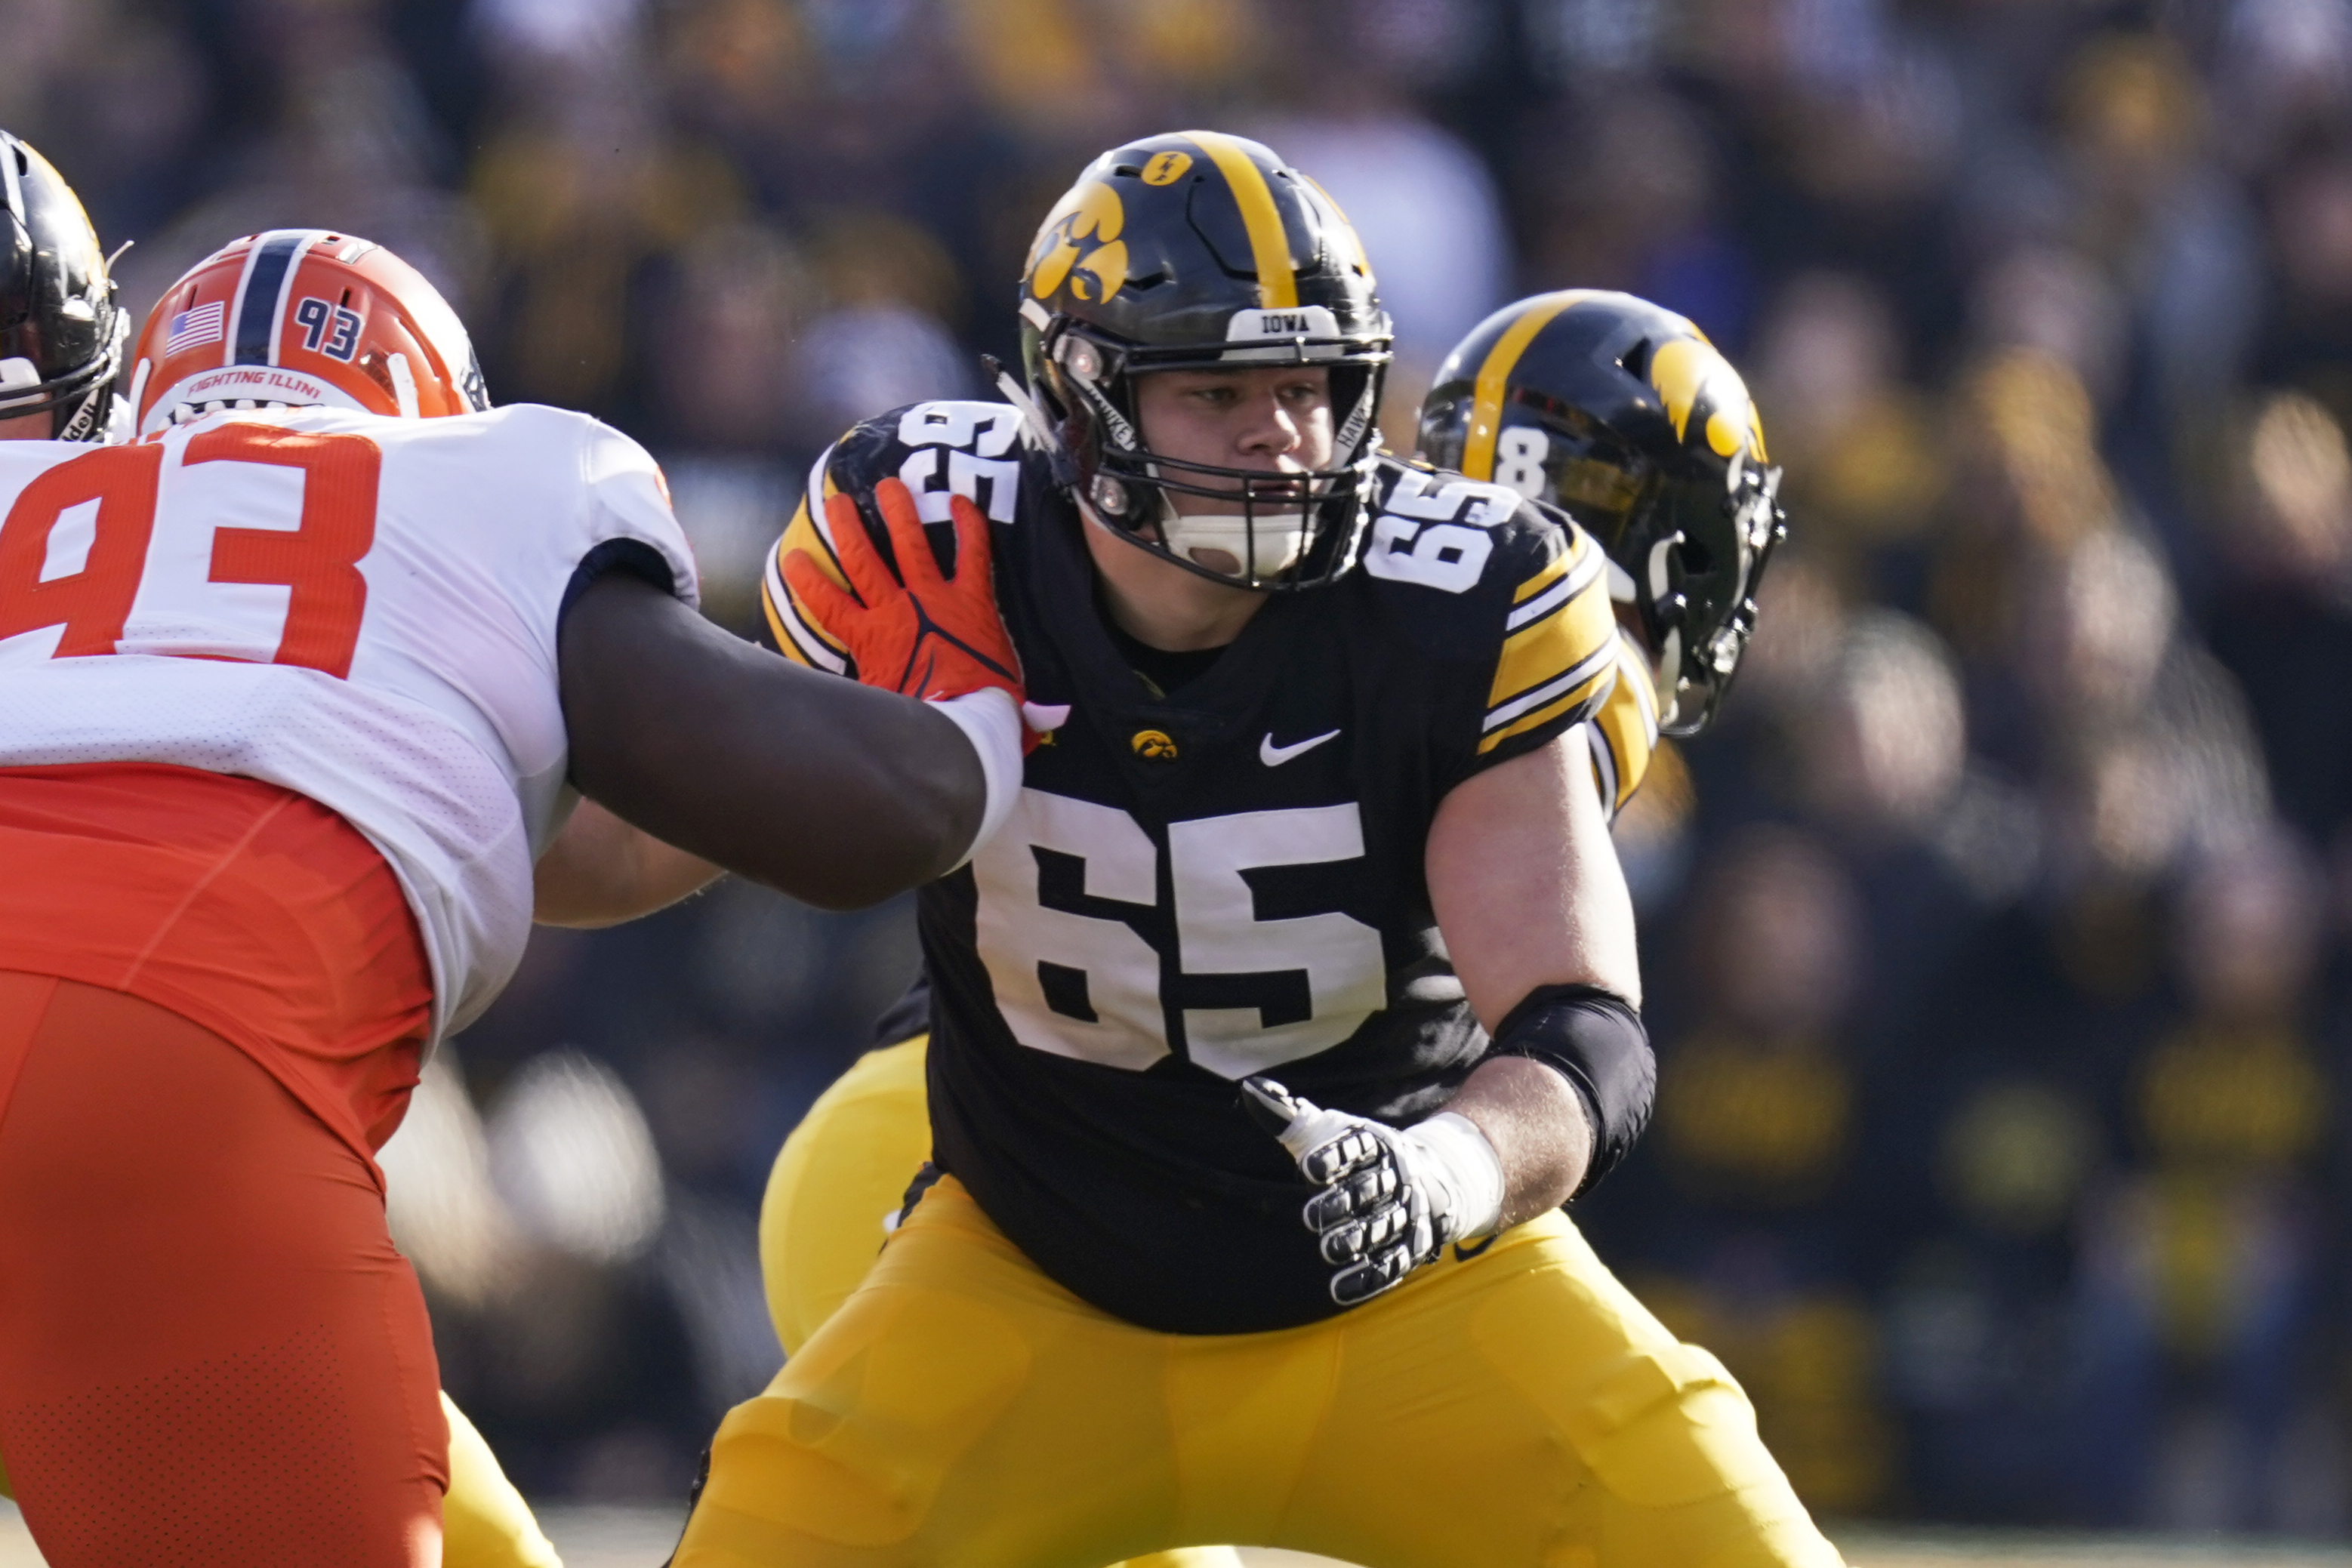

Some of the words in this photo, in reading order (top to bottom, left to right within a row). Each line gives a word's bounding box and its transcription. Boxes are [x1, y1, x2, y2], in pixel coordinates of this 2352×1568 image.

[294, 296, 365, 365] 93
[1262, 313, 1310, 334] IOWA
[187, 371, 267, 398] FIGHTING
[268, 373, 322, 399] ILLINI
[897, 400, 1025, 525] 65
[1495, 425, 1550, 500] 8
[0, 420, 383, 681] 93
[1362, 470, 1523, 595] 65
[972, 786, 1388, 1082] 65
